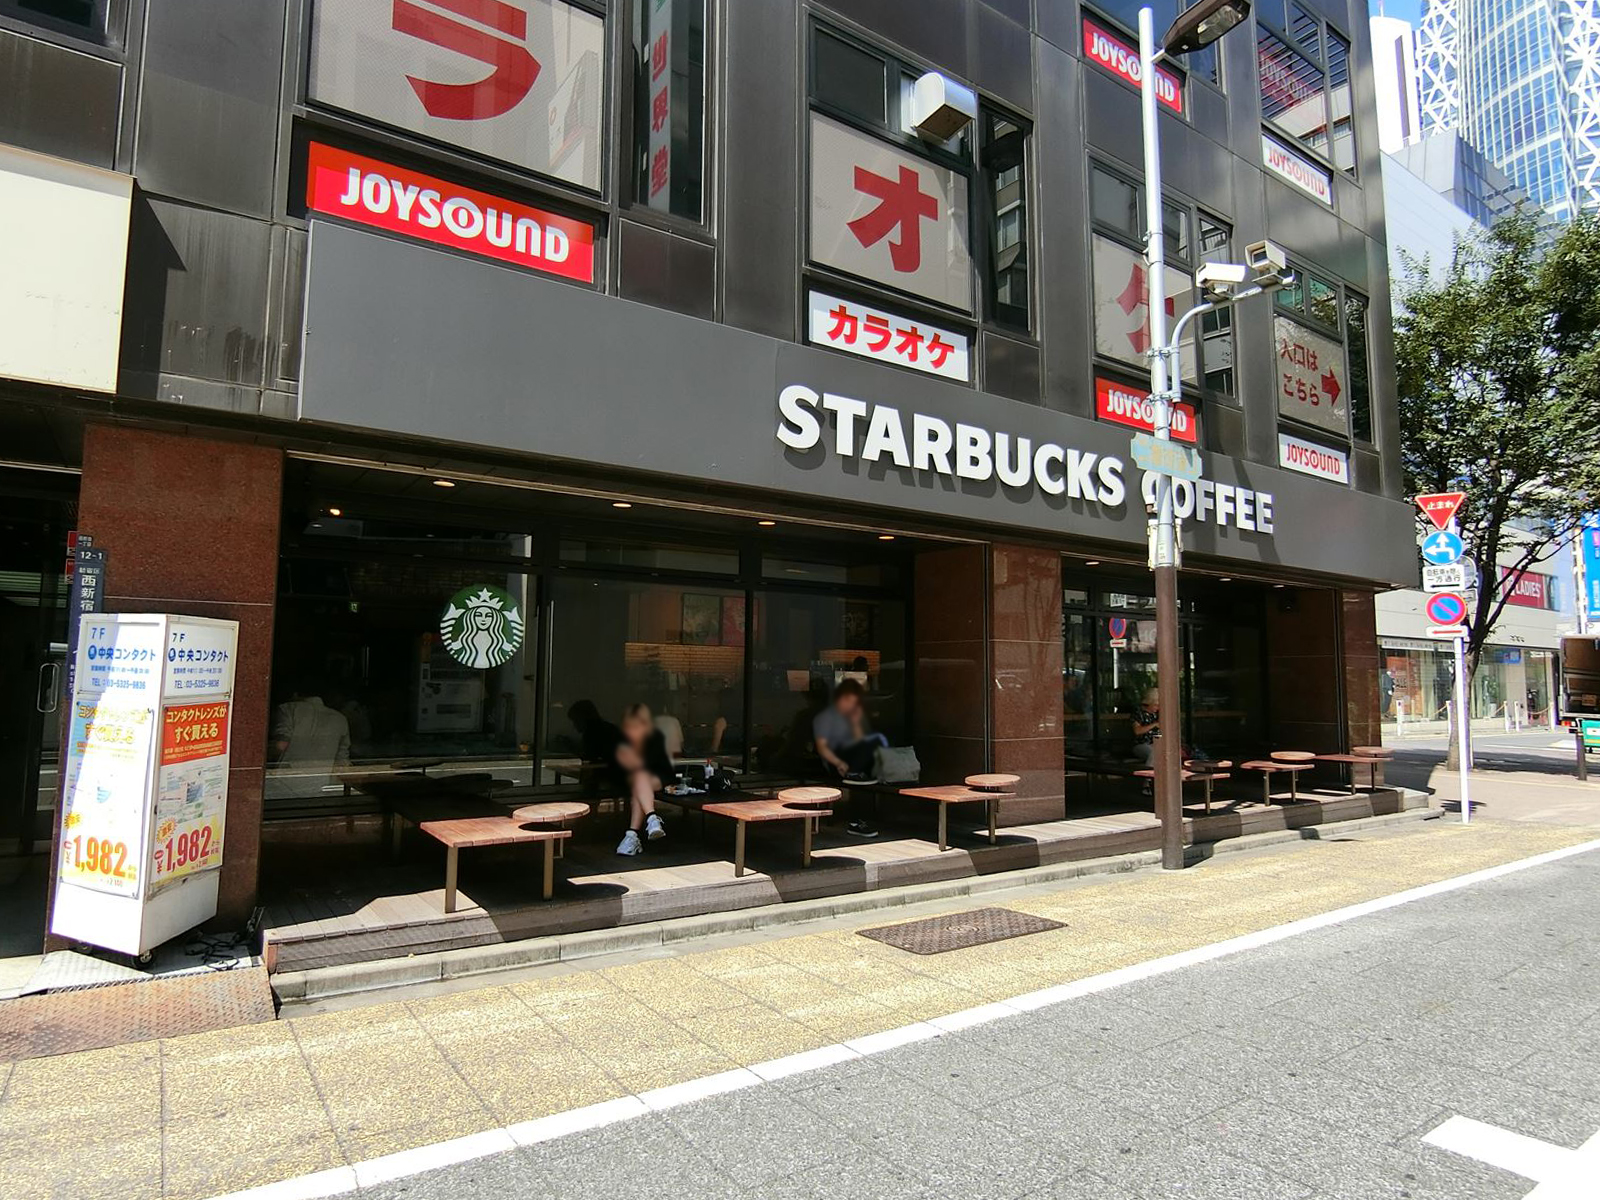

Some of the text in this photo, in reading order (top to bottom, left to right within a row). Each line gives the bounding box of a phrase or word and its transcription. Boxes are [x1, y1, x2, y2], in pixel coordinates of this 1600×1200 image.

[391, 0, 541, 120] ラ
[1092, 33, 1174, 102] JOYSOND
[1268, 146, 1325, 197] JOYSOUND
[340, 167, 570, 263] JOYSOUND
[846, 165, 938, 273] オ
[827, 304, 955, 369] カラオケ
[1281, 337, 1318, 371] 入口は
[1283, 373, 1320, 406] こちら
[1107, 389, 1187, 432] JOYSOND
[776, 385, 1124, 507] STARBUCKS
[1286, 442, 1341, 475] JOYSOUND
[1426, 500, 1455, 510] 止まれ
[80, 551, 103, 560] 12-1
[178, 649, 228, 662] 中央コンタクト
[166, 705, 227, 723] コンタクトレンズが
[174, 722, 219, 743] すぐ買える
